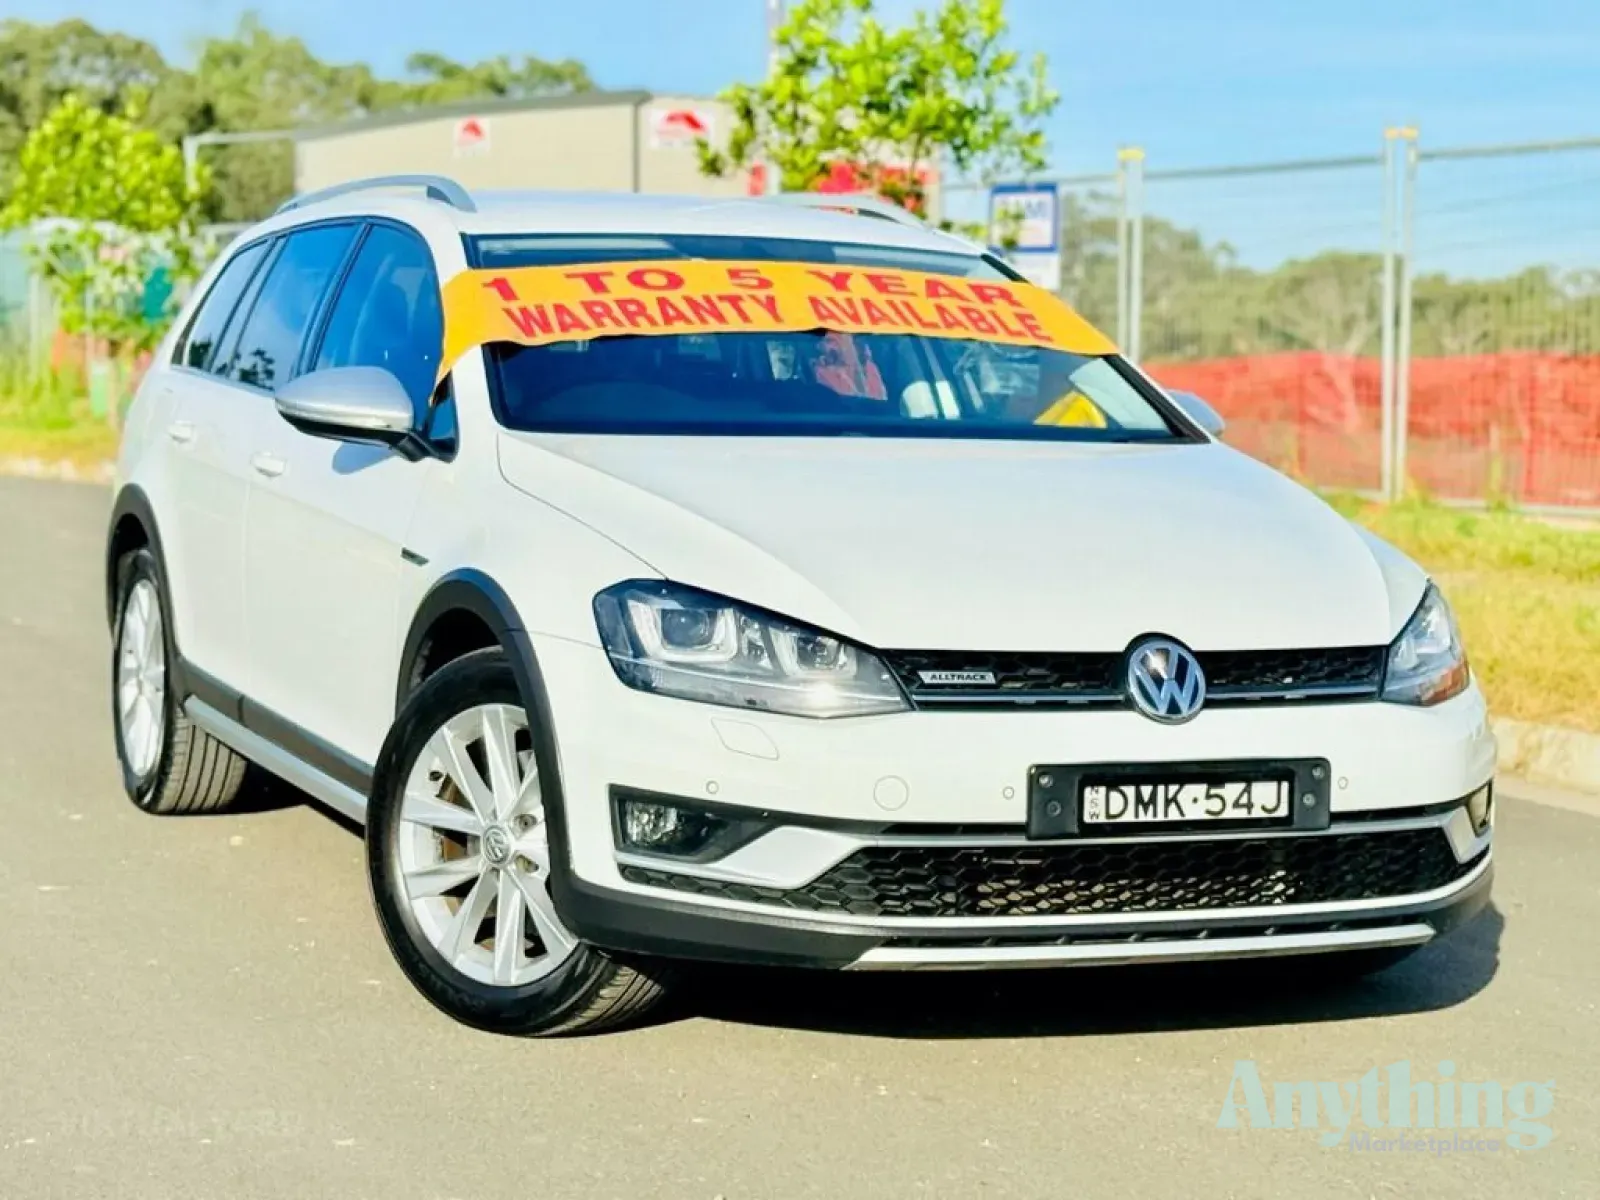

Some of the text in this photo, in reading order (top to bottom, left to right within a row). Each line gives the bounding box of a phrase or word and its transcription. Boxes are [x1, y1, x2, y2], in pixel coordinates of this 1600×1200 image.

[482, 268, 1026, 309] 1 TO 5 YEAR
[501, 293, 1054, 342] WARRANTY AVAILABLE
[930, 673, 988, 681] ALLTRACK
